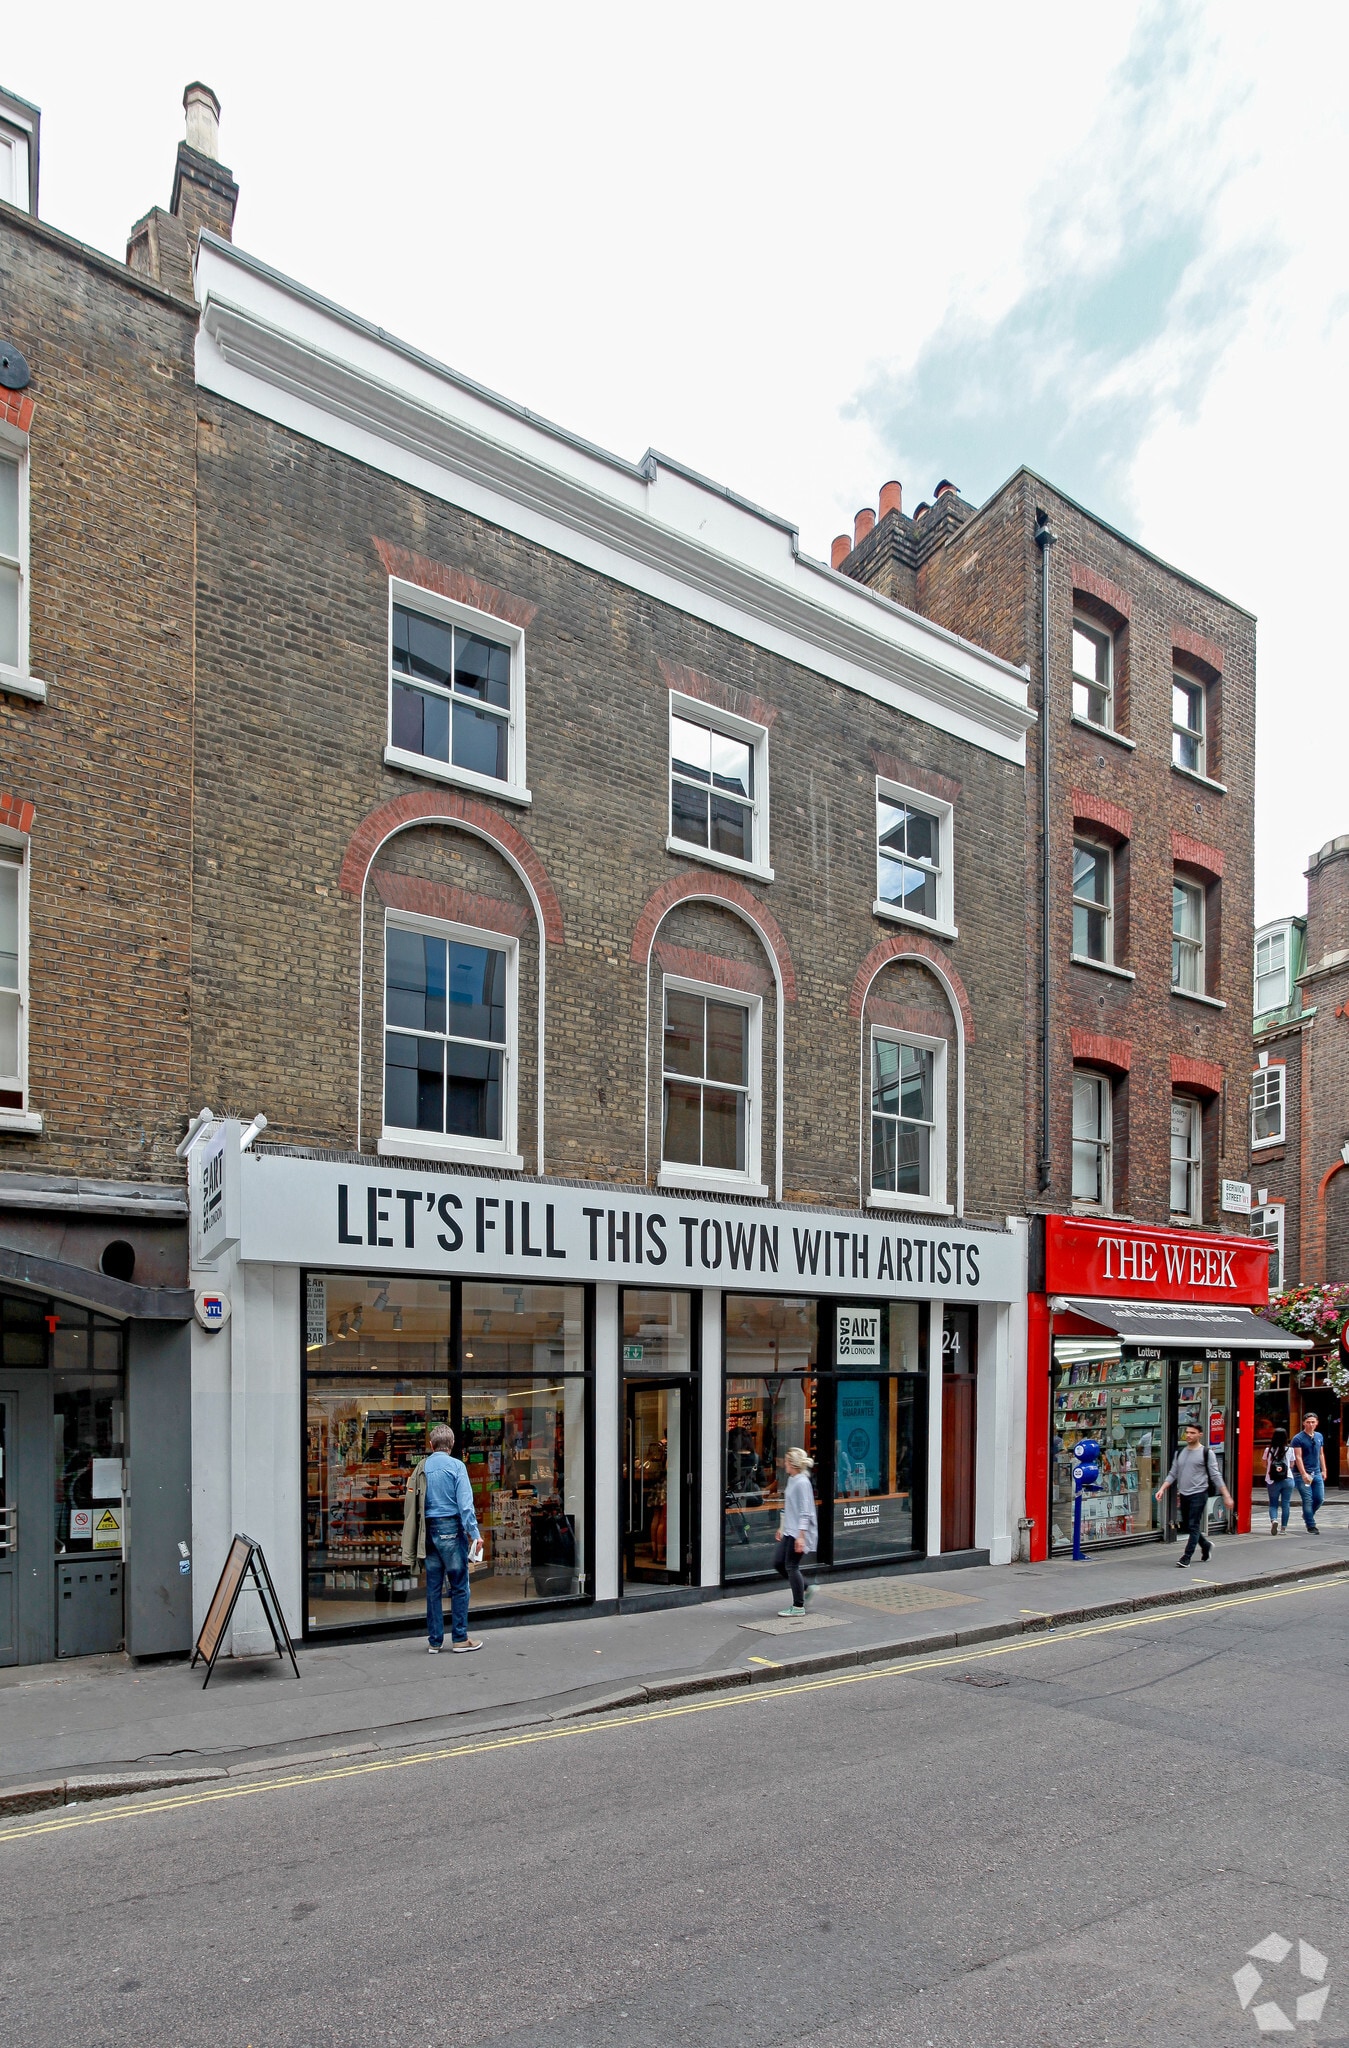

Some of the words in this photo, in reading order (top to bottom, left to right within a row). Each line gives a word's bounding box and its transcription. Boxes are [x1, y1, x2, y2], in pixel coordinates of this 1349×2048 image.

[209, 1148, 223, 1196] ART
[1226, 1183, 1245, 1193] BERWICK
[1226, 1193, 1241, 1202] STREET
[209, 1207, 222, 1228] LONDON
[338, 1184, 464, 1252] LET'S
[475, 1197, 567, 1259] FILL
[582, 1207, 668, 1266] THIS
[679, 1216, 779, 1273] TOWN
[792, 1227, 869, 1279] WITH
[877, 1236, 980, 1286] ARTISTS
[1097, 1236, 1158, 1282] THE
[1161, 1244, 1238, 1288] WEEK
[204, 1306, 221, 1314] MTL
[851, 1317, 877, 1337] ART
[840, 1317, 850, 1355] CASS
[942, 1331, 961, 1354] 24
[851, 1347, 875, 1355] LONDON
[1137, 1347, 1161, 1359] Lottery
[1206, 1349, 1217, 1358] Bus
[1218, 1349, 1231, 1359] Pass
[1260, 1350, 1290, 1361] Newsagent
[842, 1407, 874, 1417] GUARANTEE
[844, 1507, 857, 1516] CLICK
[861, 1505, 880, 1514] COLLECT
